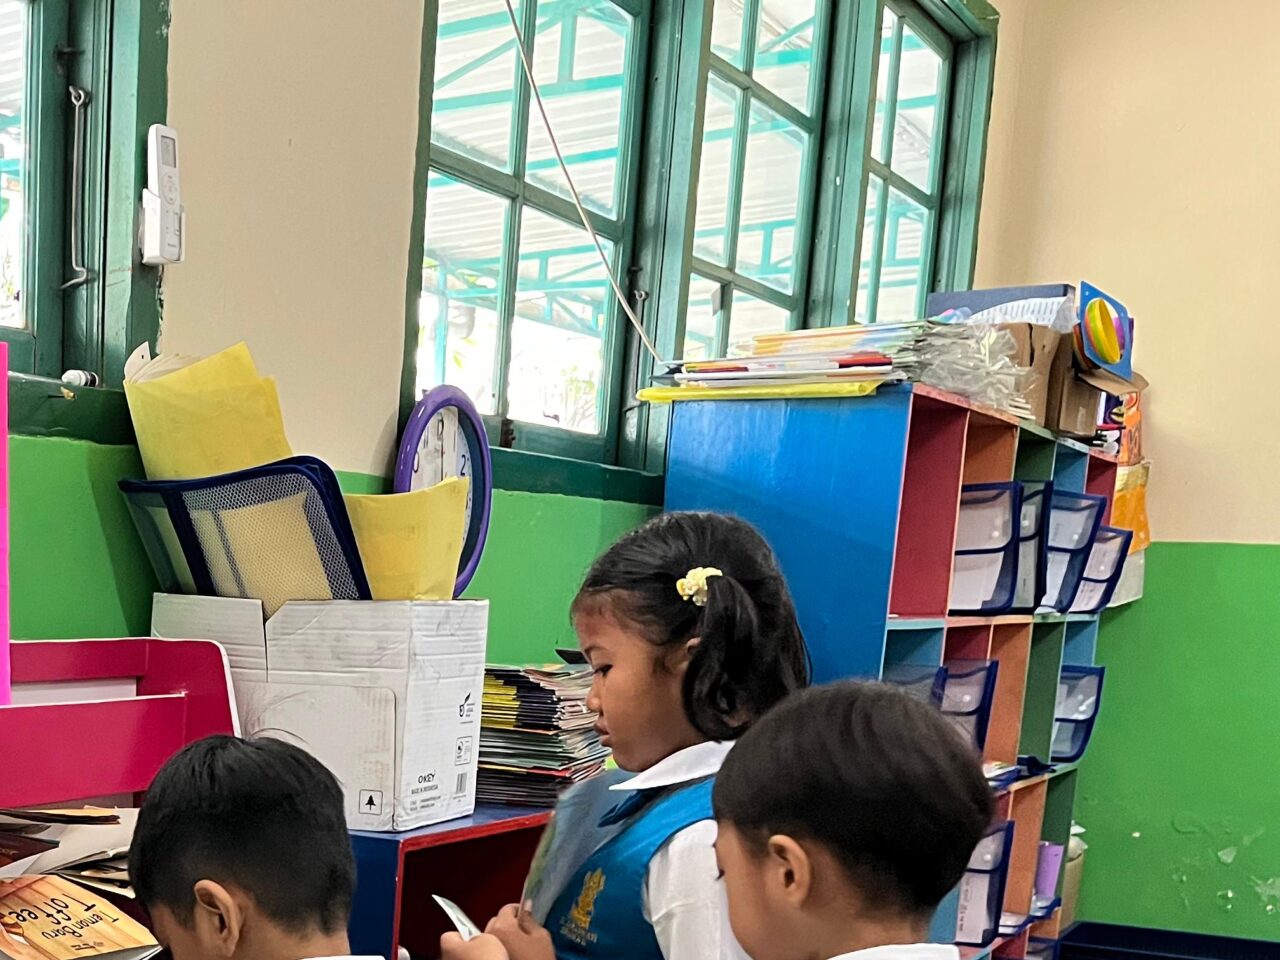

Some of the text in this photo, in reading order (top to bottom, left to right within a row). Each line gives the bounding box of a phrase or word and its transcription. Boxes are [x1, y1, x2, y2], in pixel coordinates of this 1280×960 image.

[460, 453, 467, 477] 2
[8, 893, 96, 925] Toffee
[41, 910, 120, 940] Teman Baru
